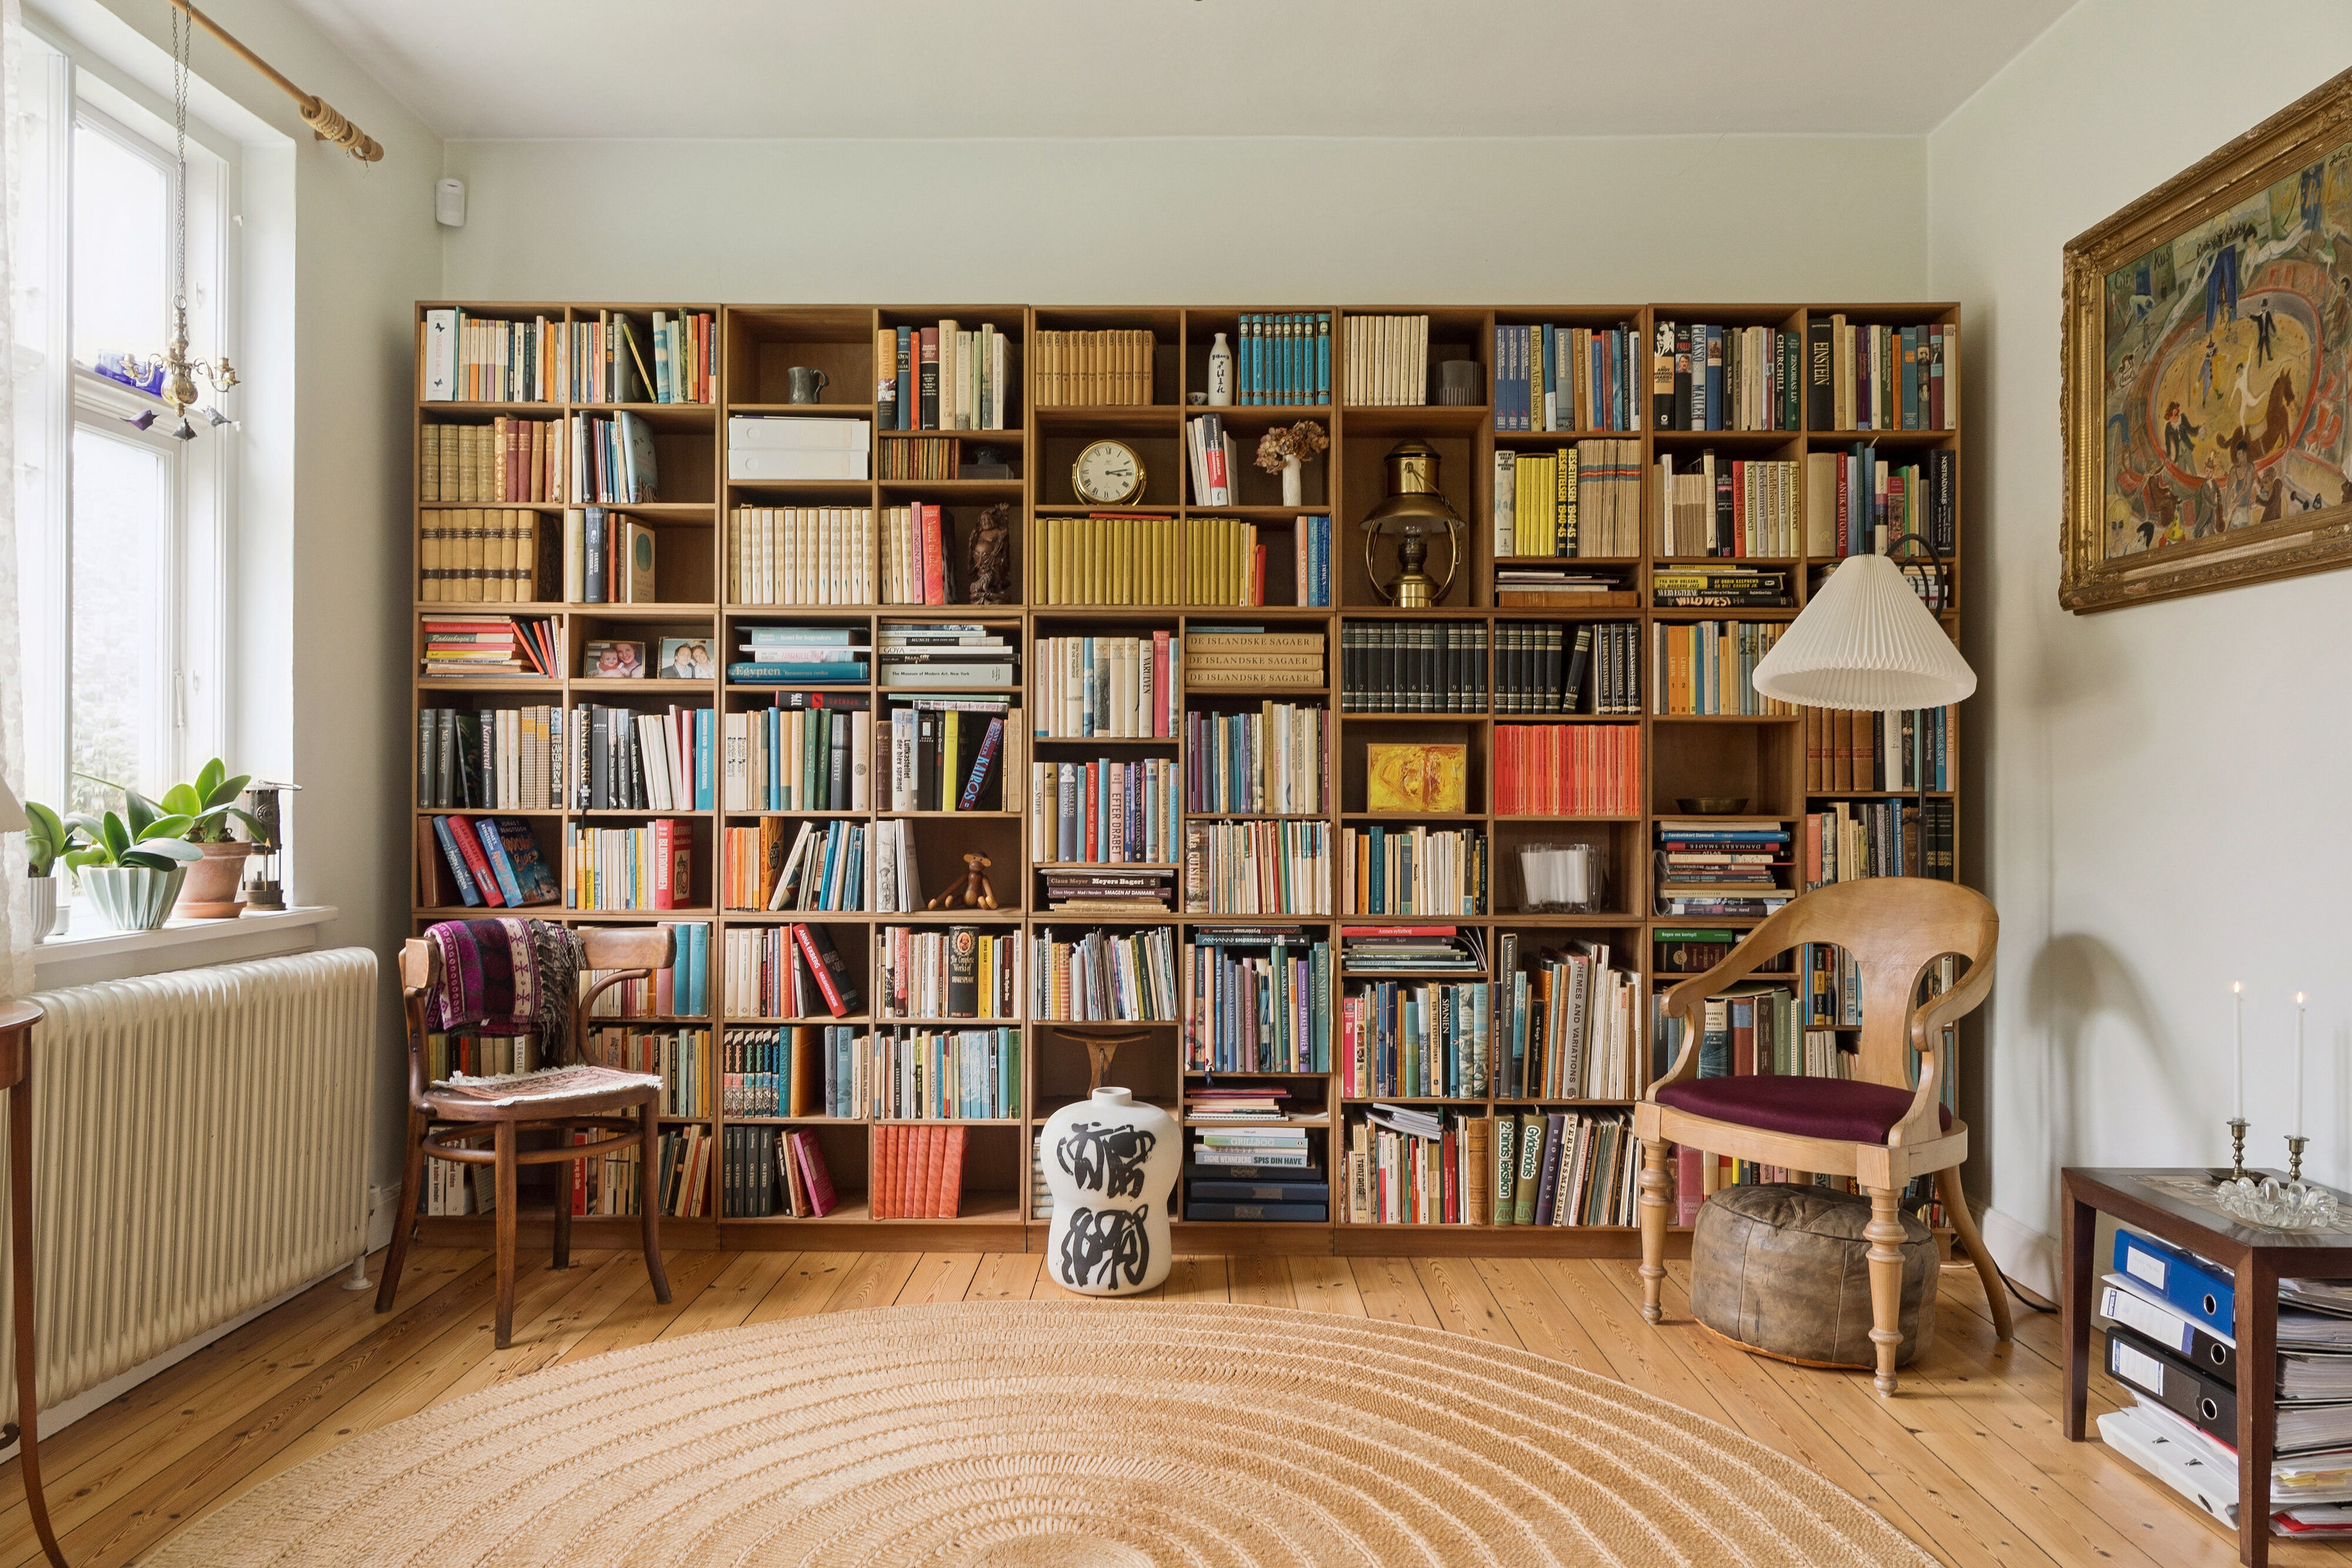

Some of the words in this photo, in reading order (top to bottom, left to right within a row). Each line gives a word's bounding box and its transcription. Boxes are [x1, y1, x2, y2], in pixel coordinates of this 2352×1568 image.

[1531, 330, 1540, 368] Politikens
[1693, 327, 1704, 362] PICASSO
[1813, 342, 1829, 386] EINSTEIN
[1693, 384, 1704, 419] MAILER
[1558, 448, 1567, 502] BESÆTTELSEN
[1568, 448, 1577, 502] BESÆTTELSEN
[1768, 465, 1777, 516] Buddhismen
[1779, 464, 1788, 514] Hinduismen
[1791, 466, 1800, 492] Japans
[1747, 465, 1755, 531] Kristendommen
[1790, 493, 1800, 530] religioner
[1558, 503, 1566, 538] 1940-45
[1568, 503, 1577, 538] 1940-45
[1675, 597, 1703, 606] WILD
[1704, 597, 1731, 605] WEST
[581, 710, 590, 736] JOHN
[483, 725, 492, 769] Karneval
[581, 747, 591, 784] CARRÉ
[963, 756, 990, 801] KAIROS
[1162, 764, 1168, 774] De
[1112, 793, 1121, 819] EFTER
[481, 824, 493, 851] BENGTSSON
[1112, 822, 1121, 855] DRABET
[1189, 833, 1200, 848] Ma
[658, 838, 667, 890] BLIKTROMMEN
[1189, 851, 1200, 895] CUISINE
[798, 929, 810, 946] ANNA
[806, 946, 821, 969] EKBERG
[1300, 1007, 1308, 1051] KØKKENHAVEN
[1569, 1027, 1580, 1083] VARIATIONS
[1500, 1123, 1513, 1157] 2-binds
[1522, 1125, 1540, 1179] Gyldendals
[1500, 1160, 1512, 1197] leksikon
[1555, 1123, 1575, 1219] VERDENSMESTRE
